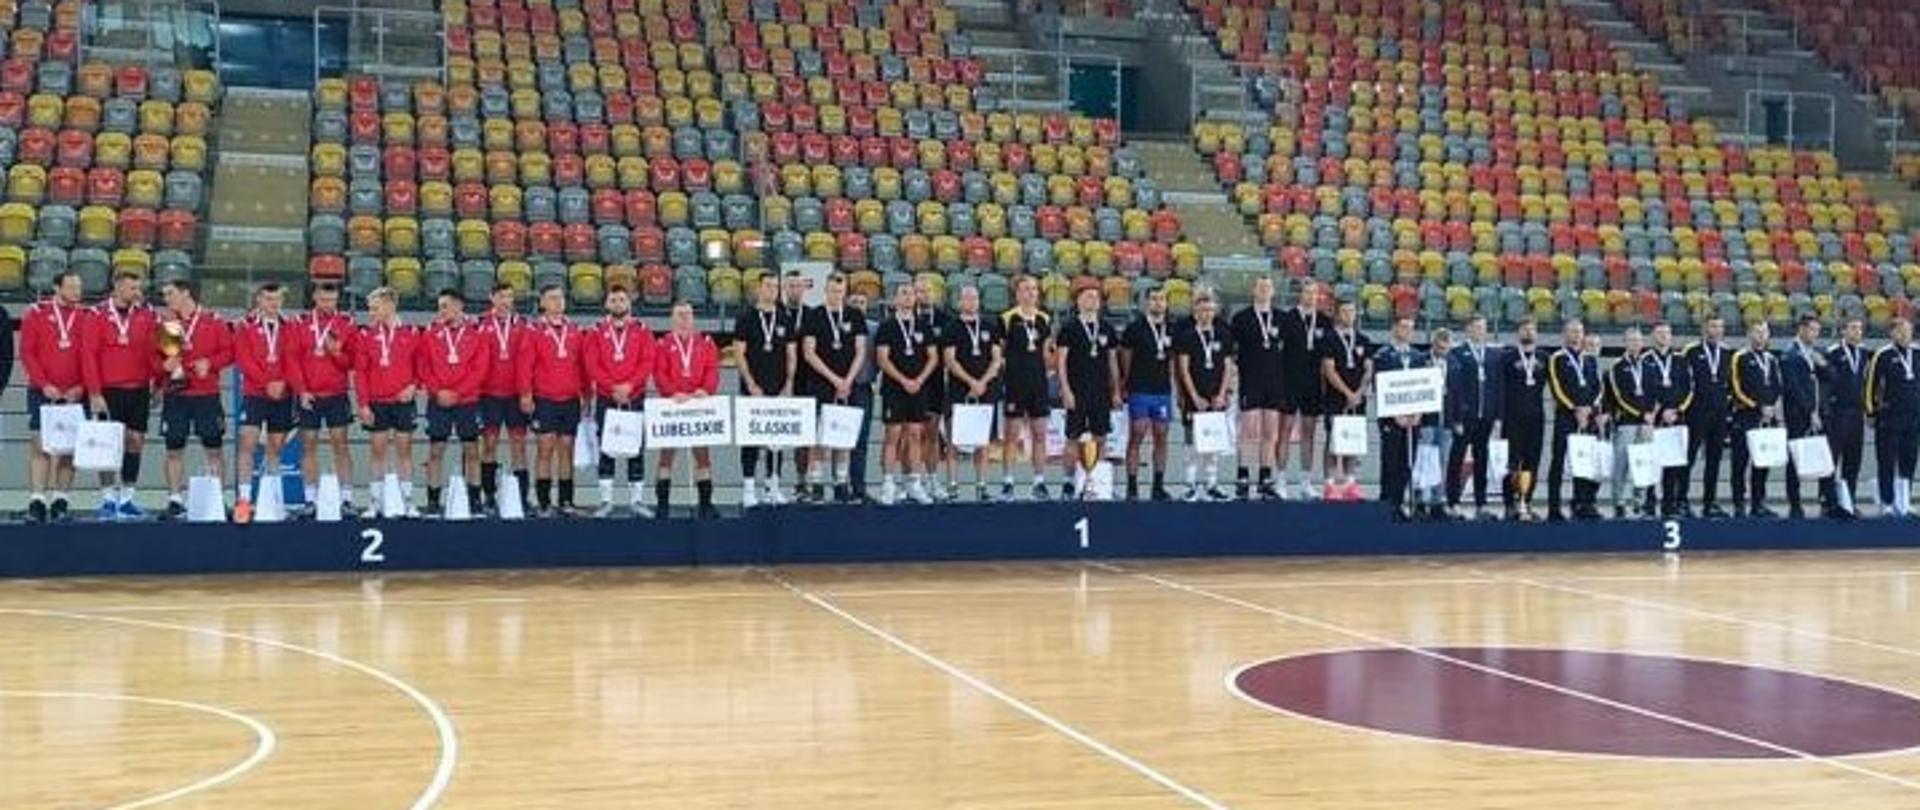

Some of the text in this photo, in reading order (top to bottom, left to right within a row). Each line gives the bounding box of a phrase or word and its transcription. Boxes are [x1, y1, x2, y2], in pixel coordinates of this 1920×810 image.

[651, 418, 725, 438] LUBELSKIE
[361, 528, 385, 562] 2
[1074, 516, 1089, 548] 1
[1663, 520, 1681, 549] 3
